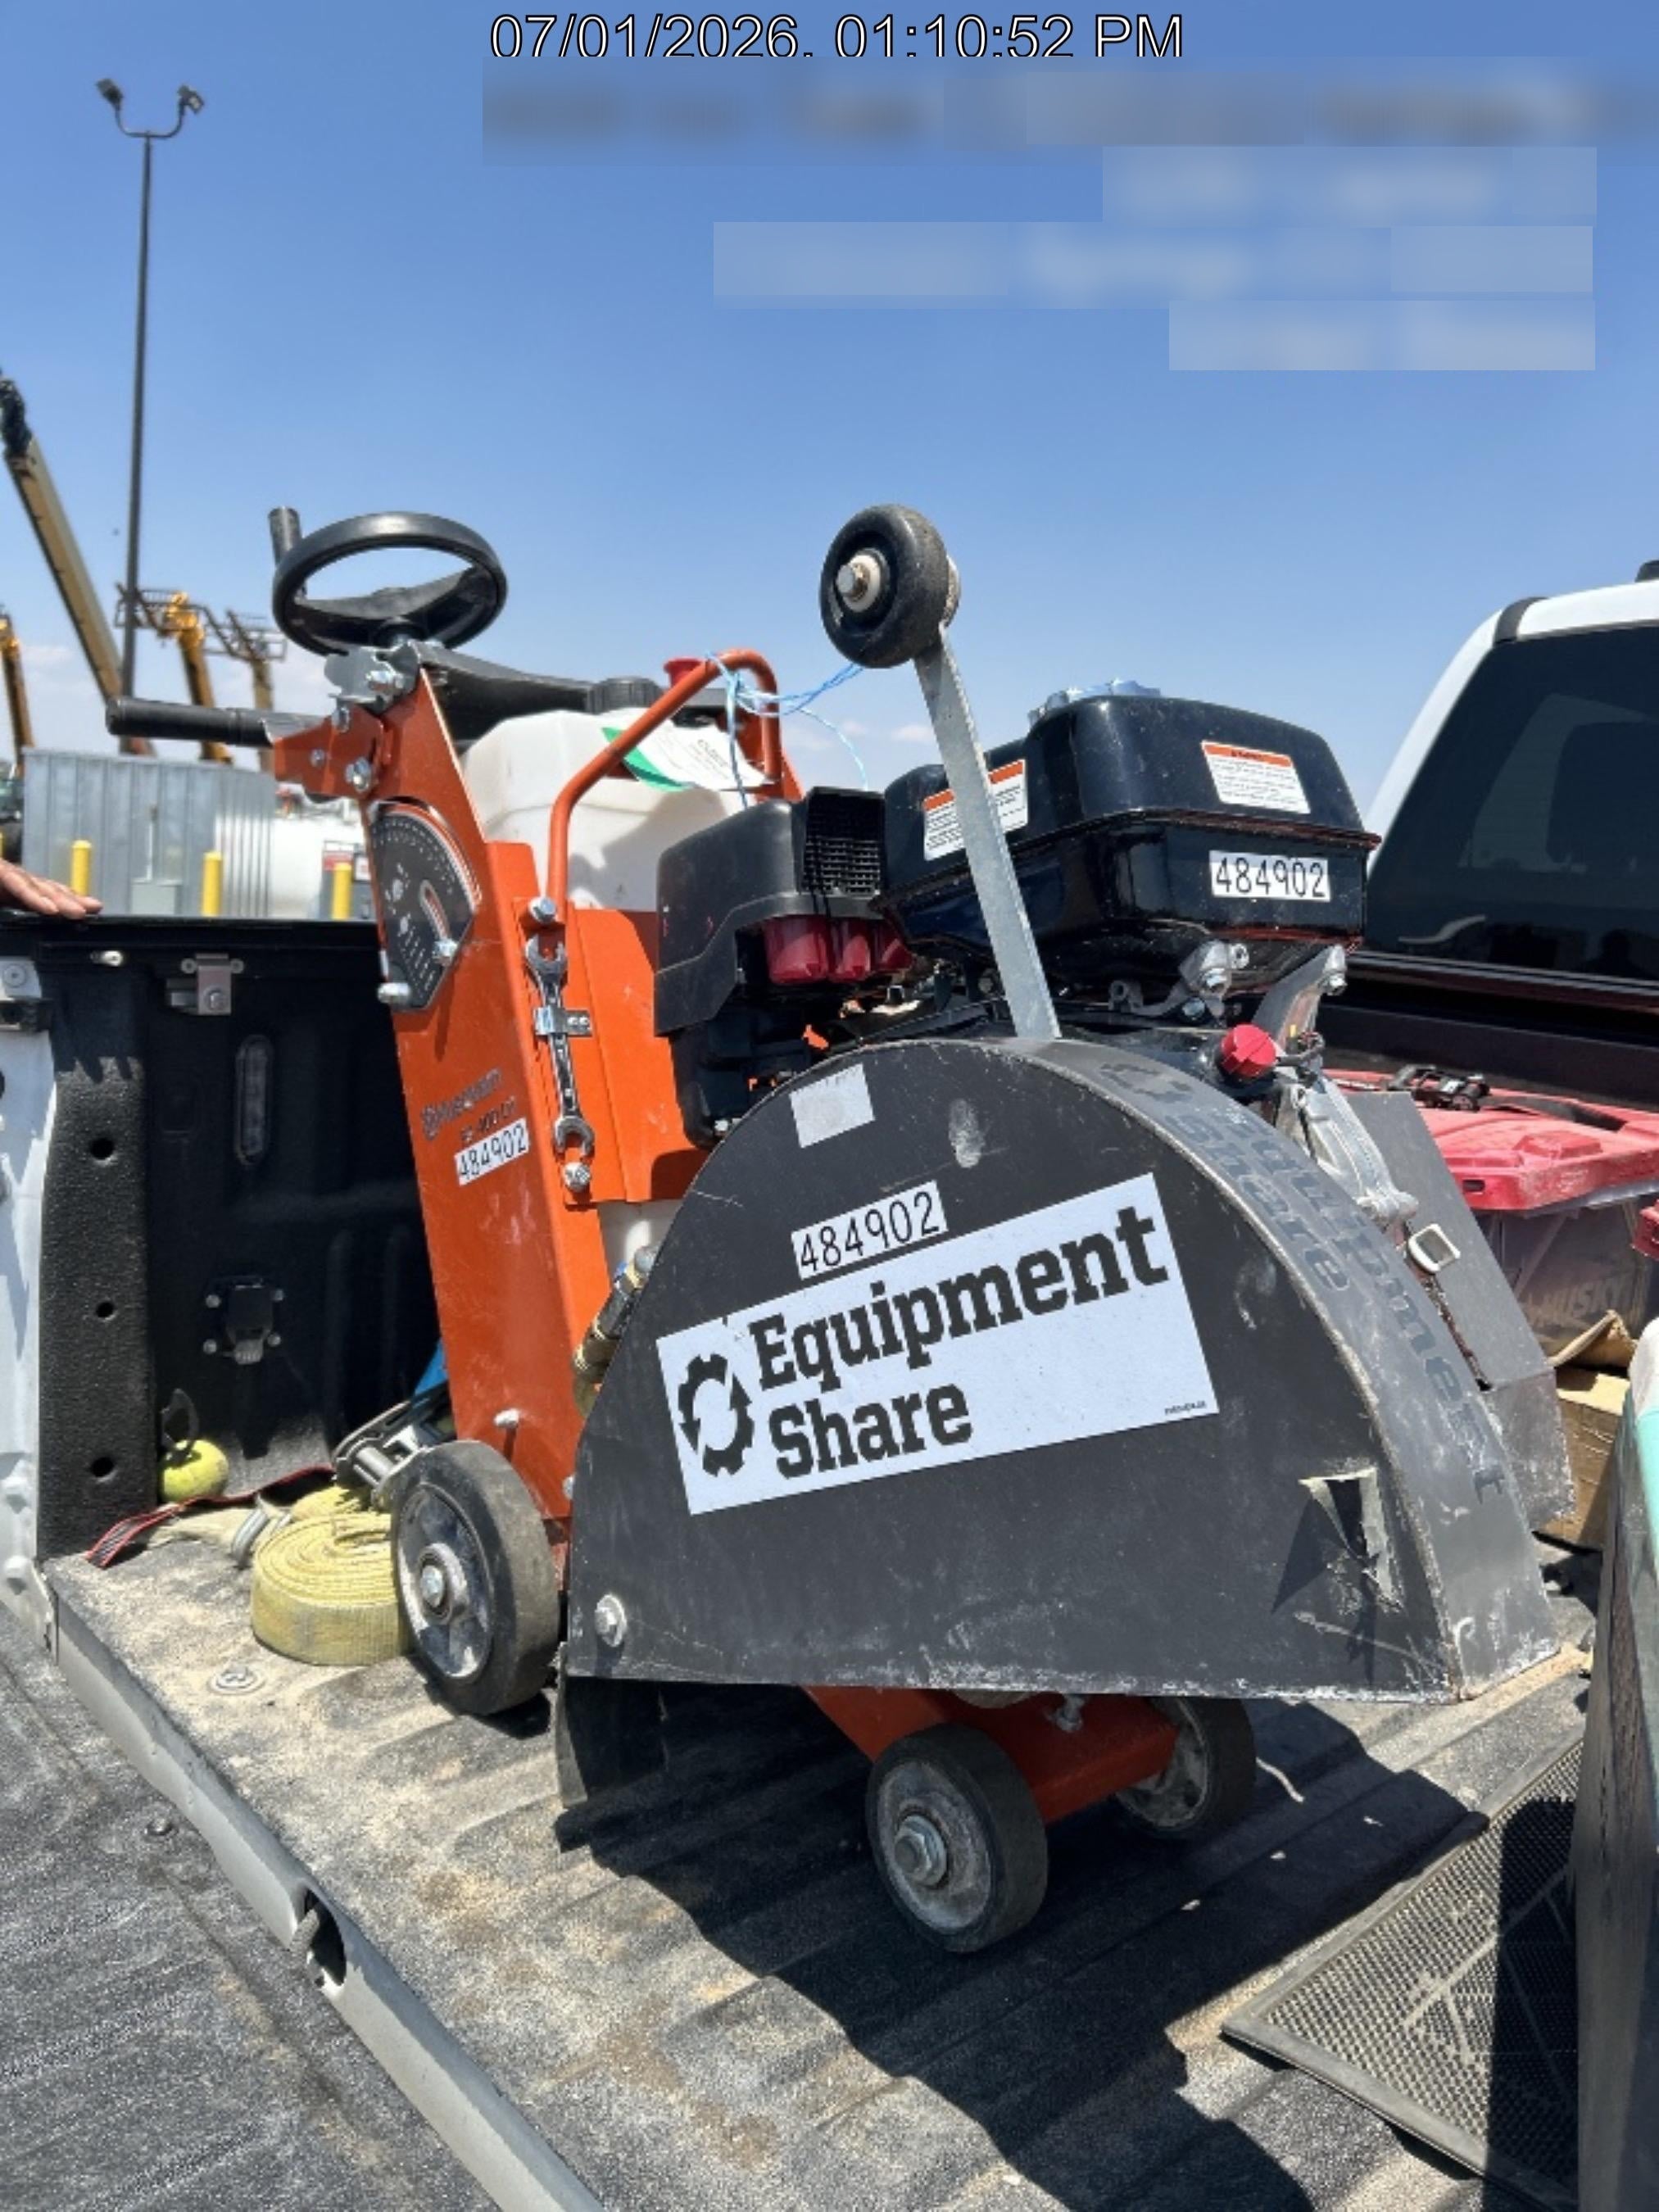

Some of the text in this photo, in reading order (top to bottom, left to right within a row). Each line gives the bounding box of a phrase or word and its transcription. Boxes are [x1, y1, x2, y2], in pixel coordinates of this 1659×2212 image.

[1216, 856, 1326, 897] 484902
[459, 1123, 526, 1180] 484902
[799, 1190, 941, 1271] 484902
[748, 1206, 1169, 1394] Equipment
[768, 1384, 973, 1478] Share
